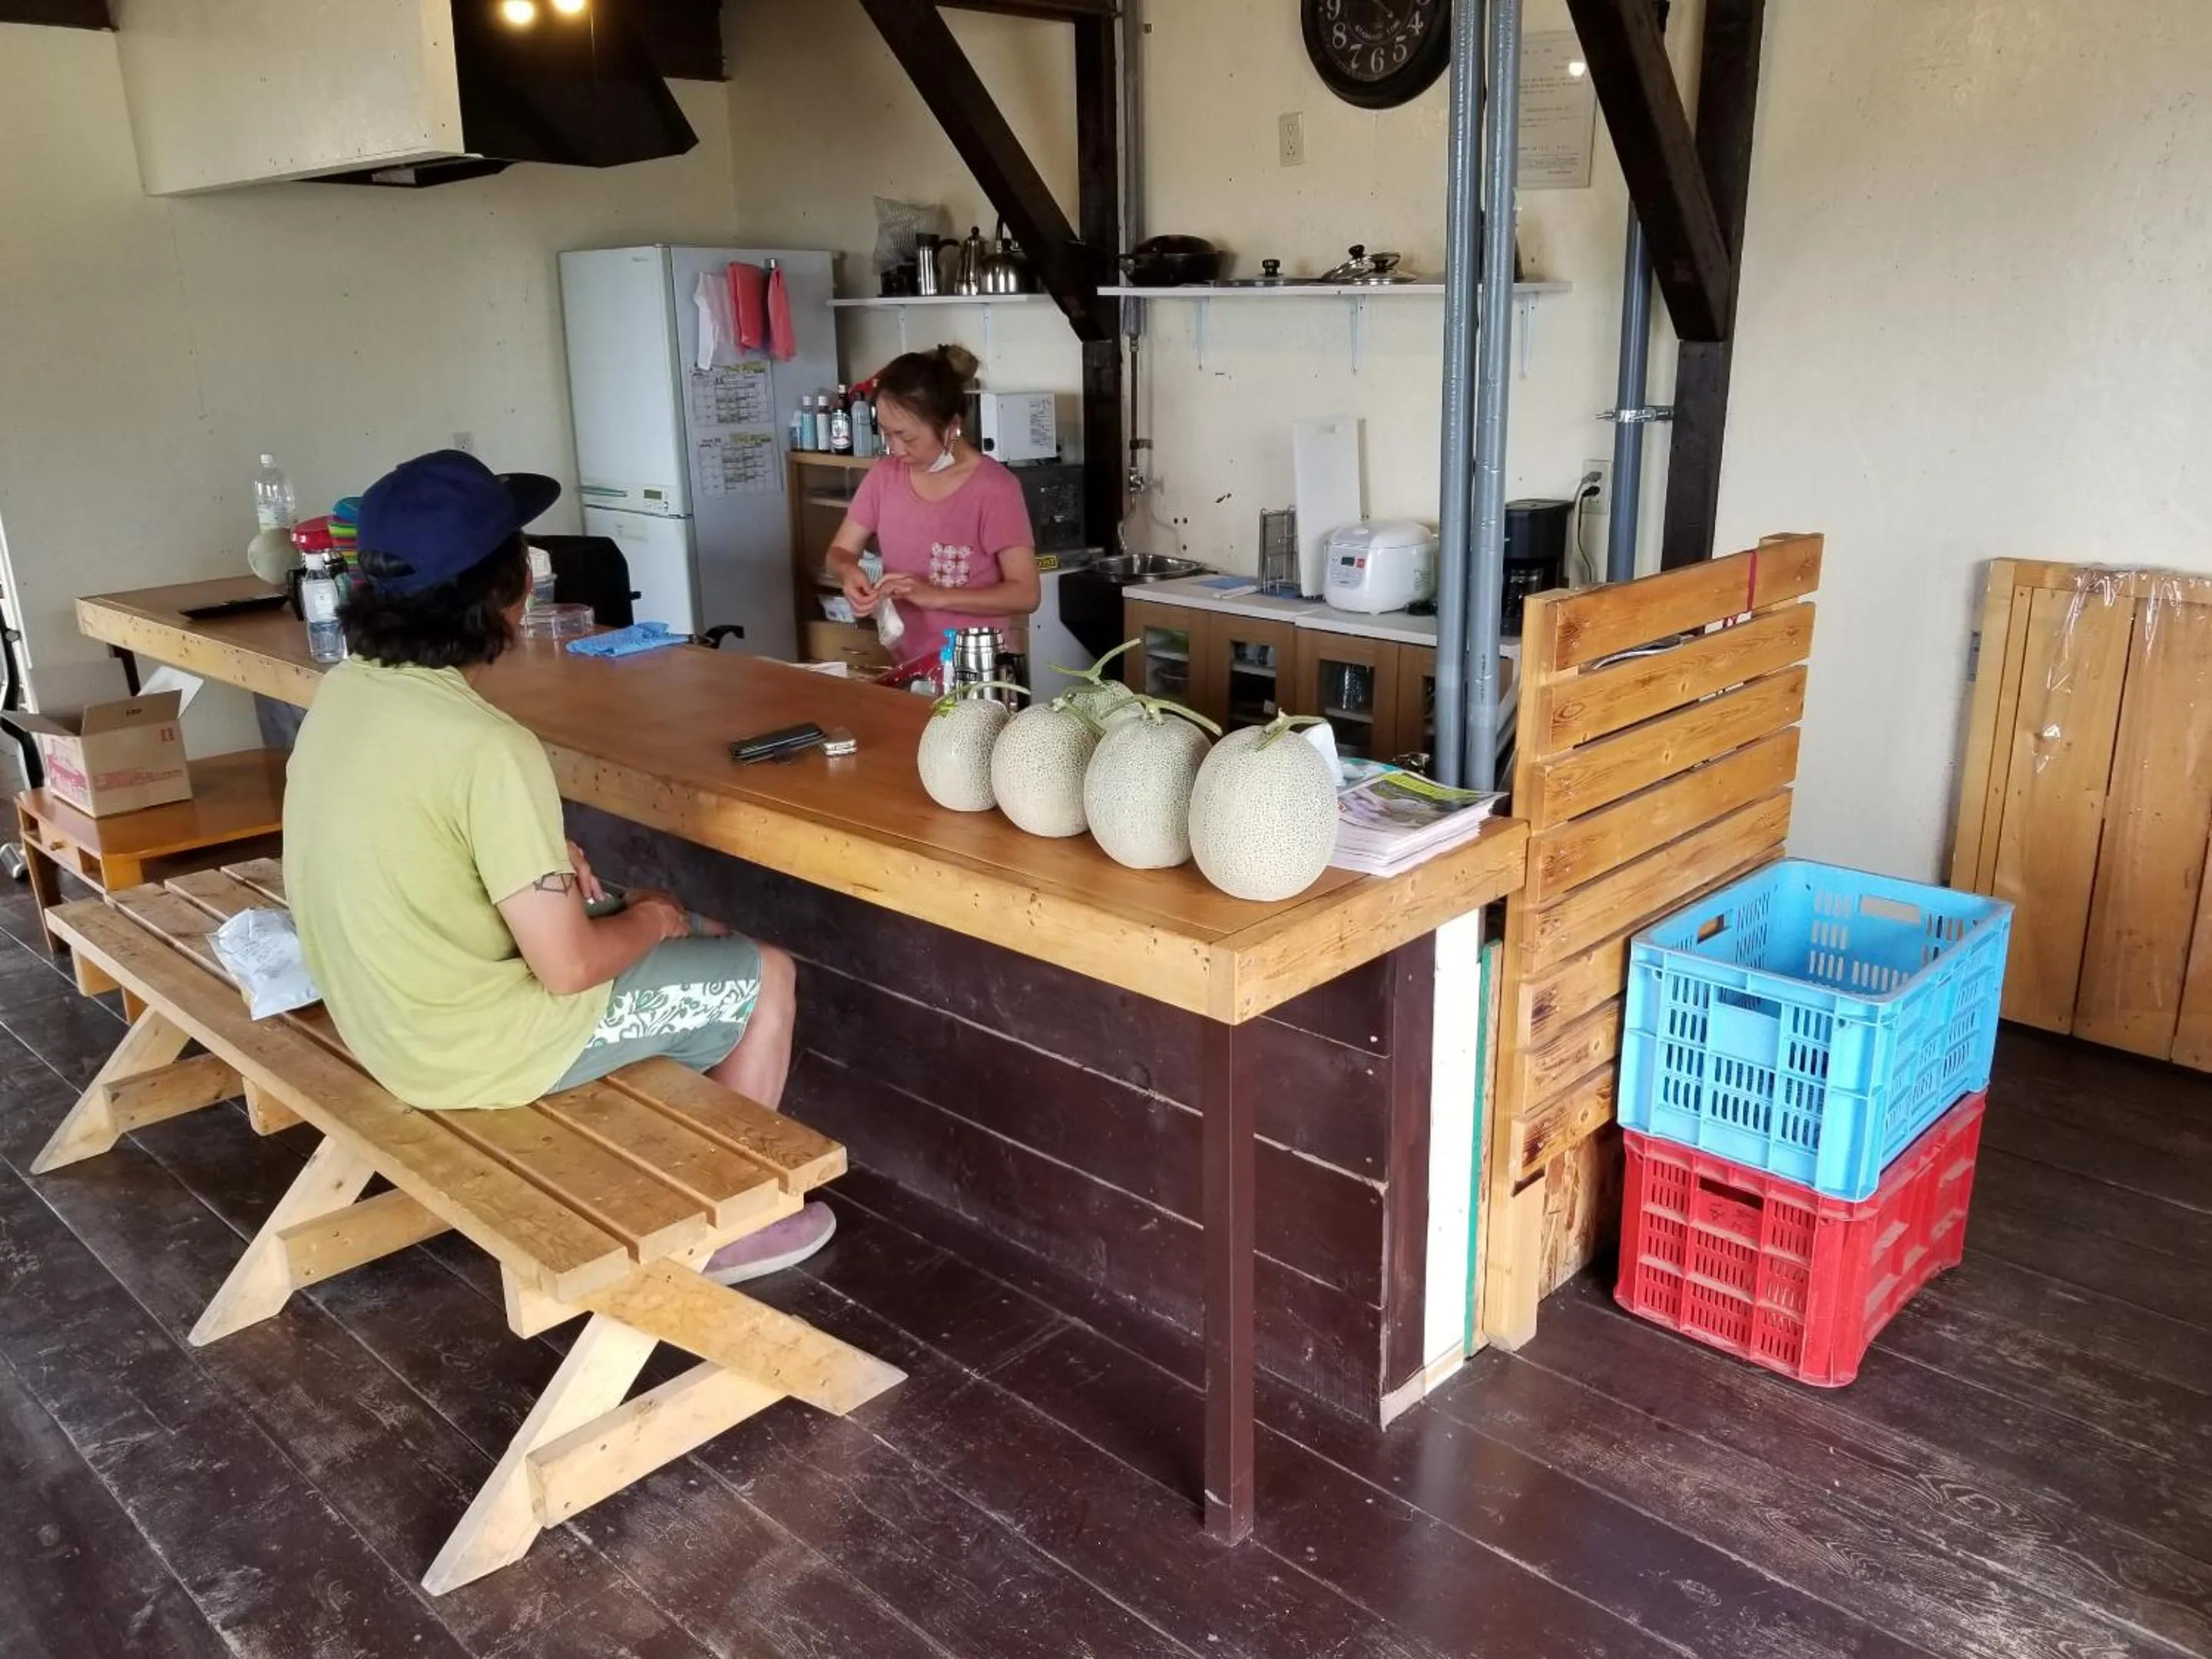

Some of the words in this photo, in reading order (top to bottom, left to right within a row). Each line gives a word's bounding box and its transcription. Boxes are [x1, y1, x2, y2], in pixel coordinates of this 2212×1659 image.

[1326, 0, 1341, 21] 9
[1407, 10, 1424, 35] 4
[1332, 22, 1347, 49] 8
[1349, 44, 1363, 70] 7
[1370, 47, 1385, 74] 6
[1392, 35, 1407, 63] 5
